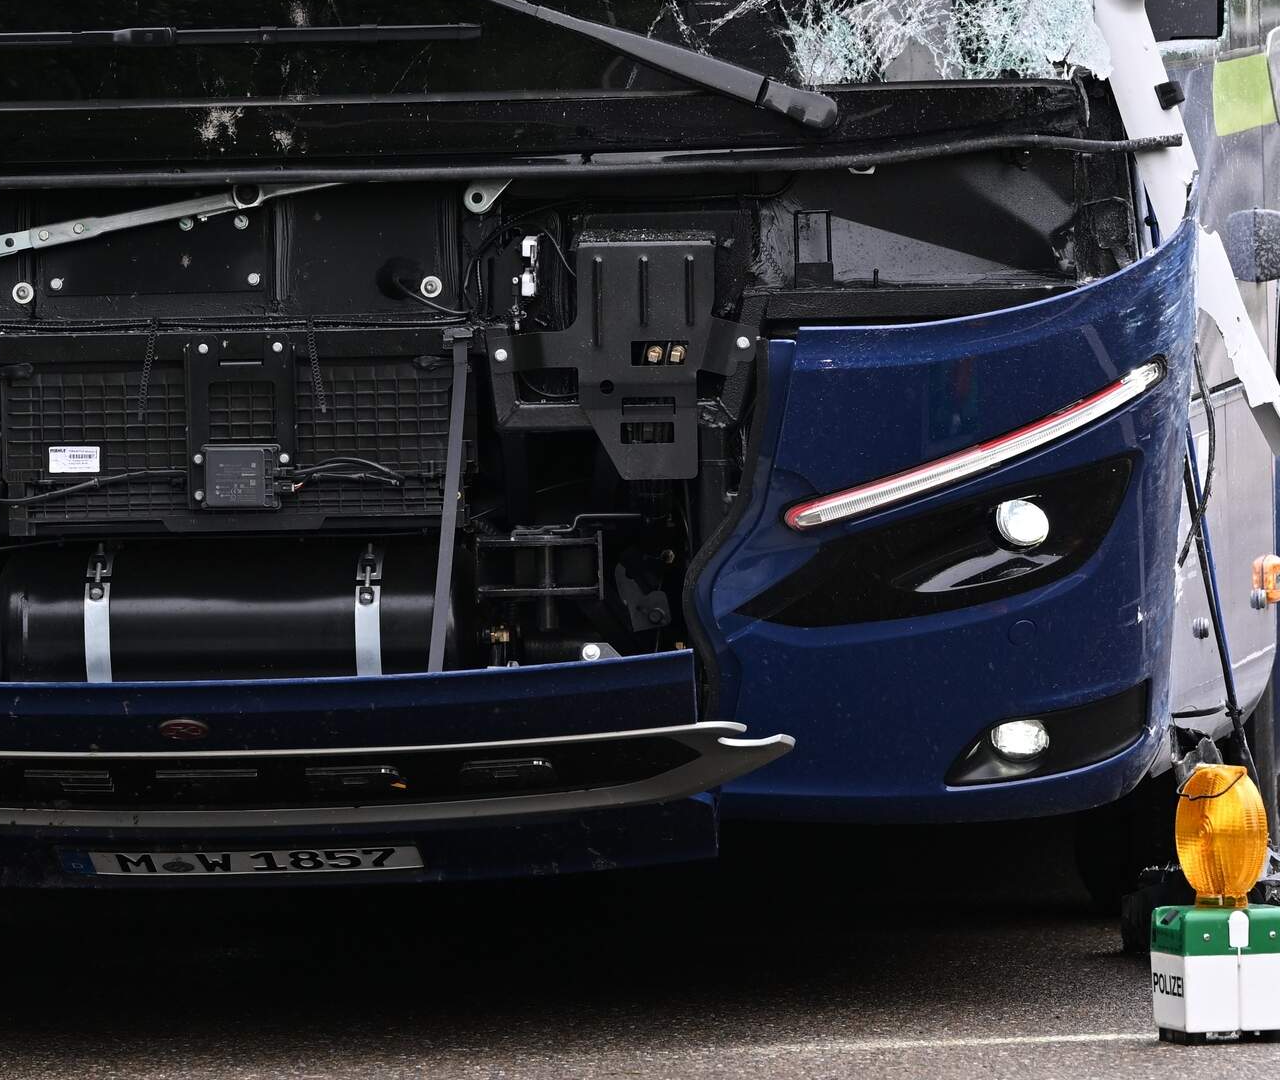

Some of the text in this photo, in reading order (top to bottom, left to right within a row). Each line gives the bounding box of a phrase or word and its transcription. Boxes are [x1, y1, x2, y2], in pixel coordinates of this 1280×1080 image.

[115, 854, 158, 873] M
[196, 854, 231, 872] W
[250, 848, 396, 871] 1857
[1153, 972, 1184, 998] POLIZEI
